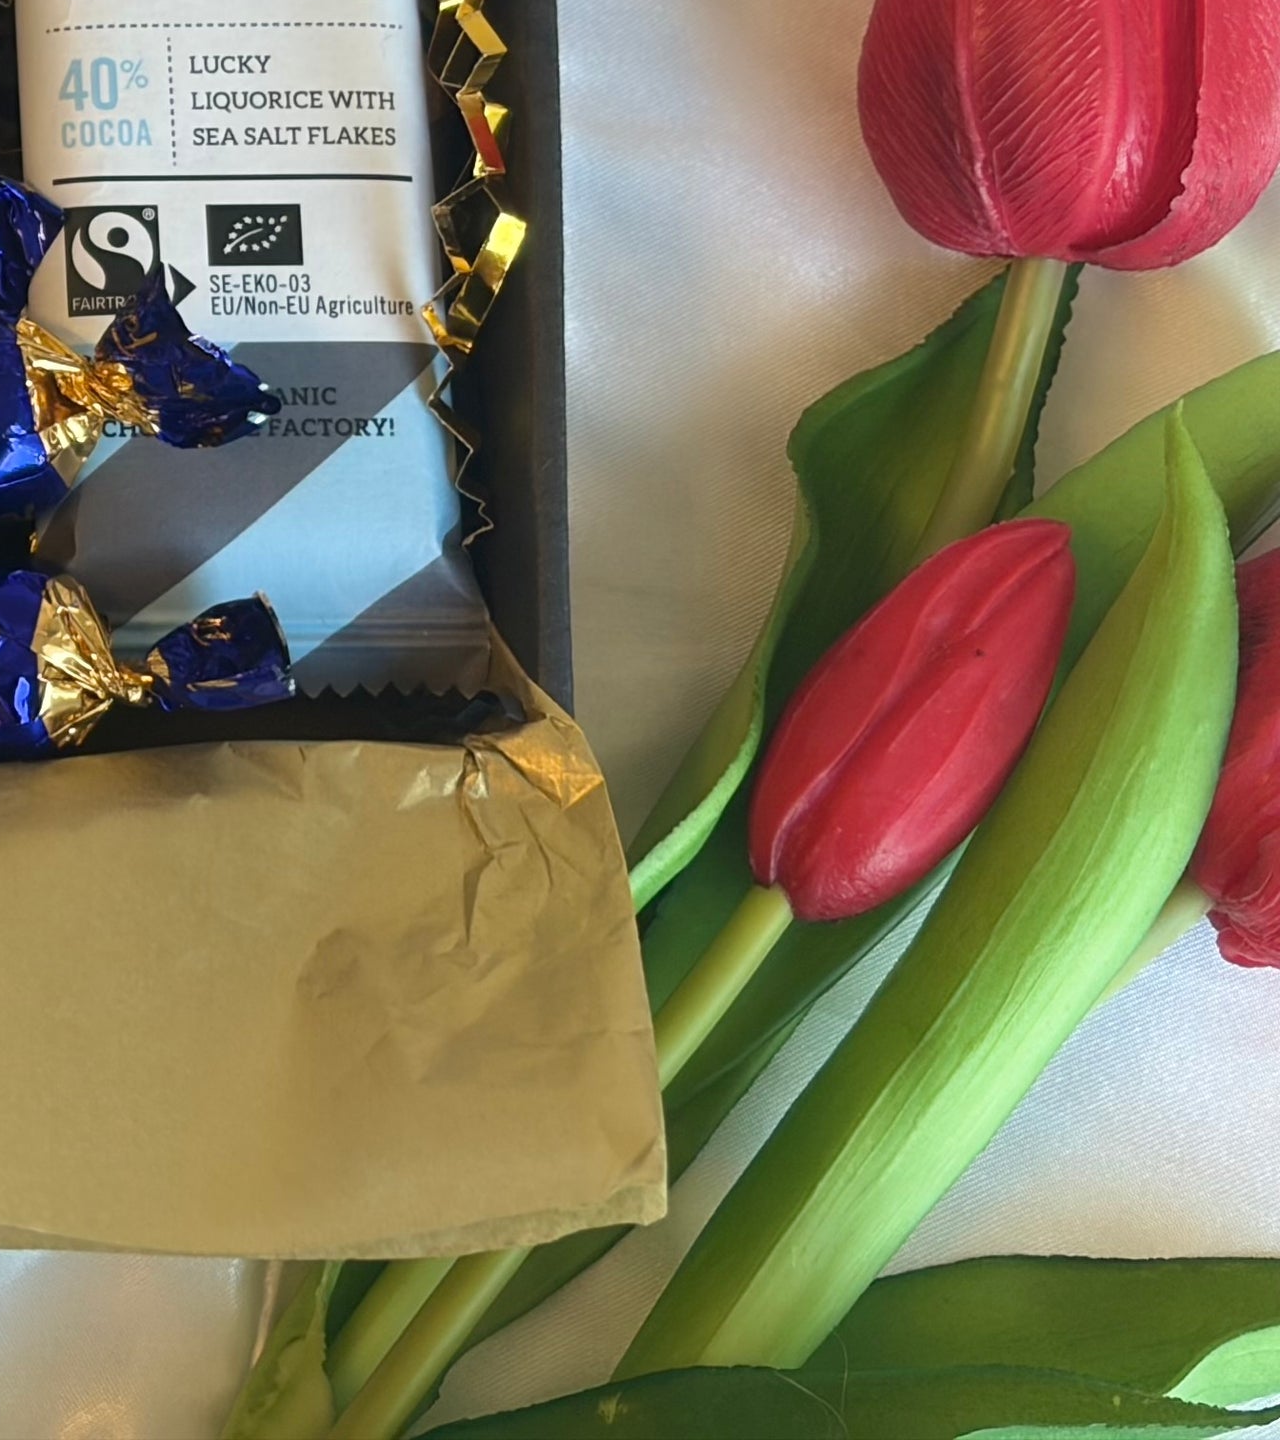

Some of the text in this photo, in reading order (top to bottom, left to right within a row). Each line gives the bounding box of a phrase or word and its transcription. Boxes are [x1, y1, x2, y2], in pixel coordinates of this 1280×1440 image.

[189, 55, 271, 74] LUCKY
[59, 56, 150, 111] 40%
[191, 90, 396, 111] LIQUORICE WITH
[61, 119, 152, 148] COCOA
[192, 126, 397, 147] SEA SALT FLAKES
[209, 274, 311, 293] SE-EKO-03
[211, 295, 414, 319] EU/Non-EU Agriculture
[269, 418, 396, 439] FACTORY!
